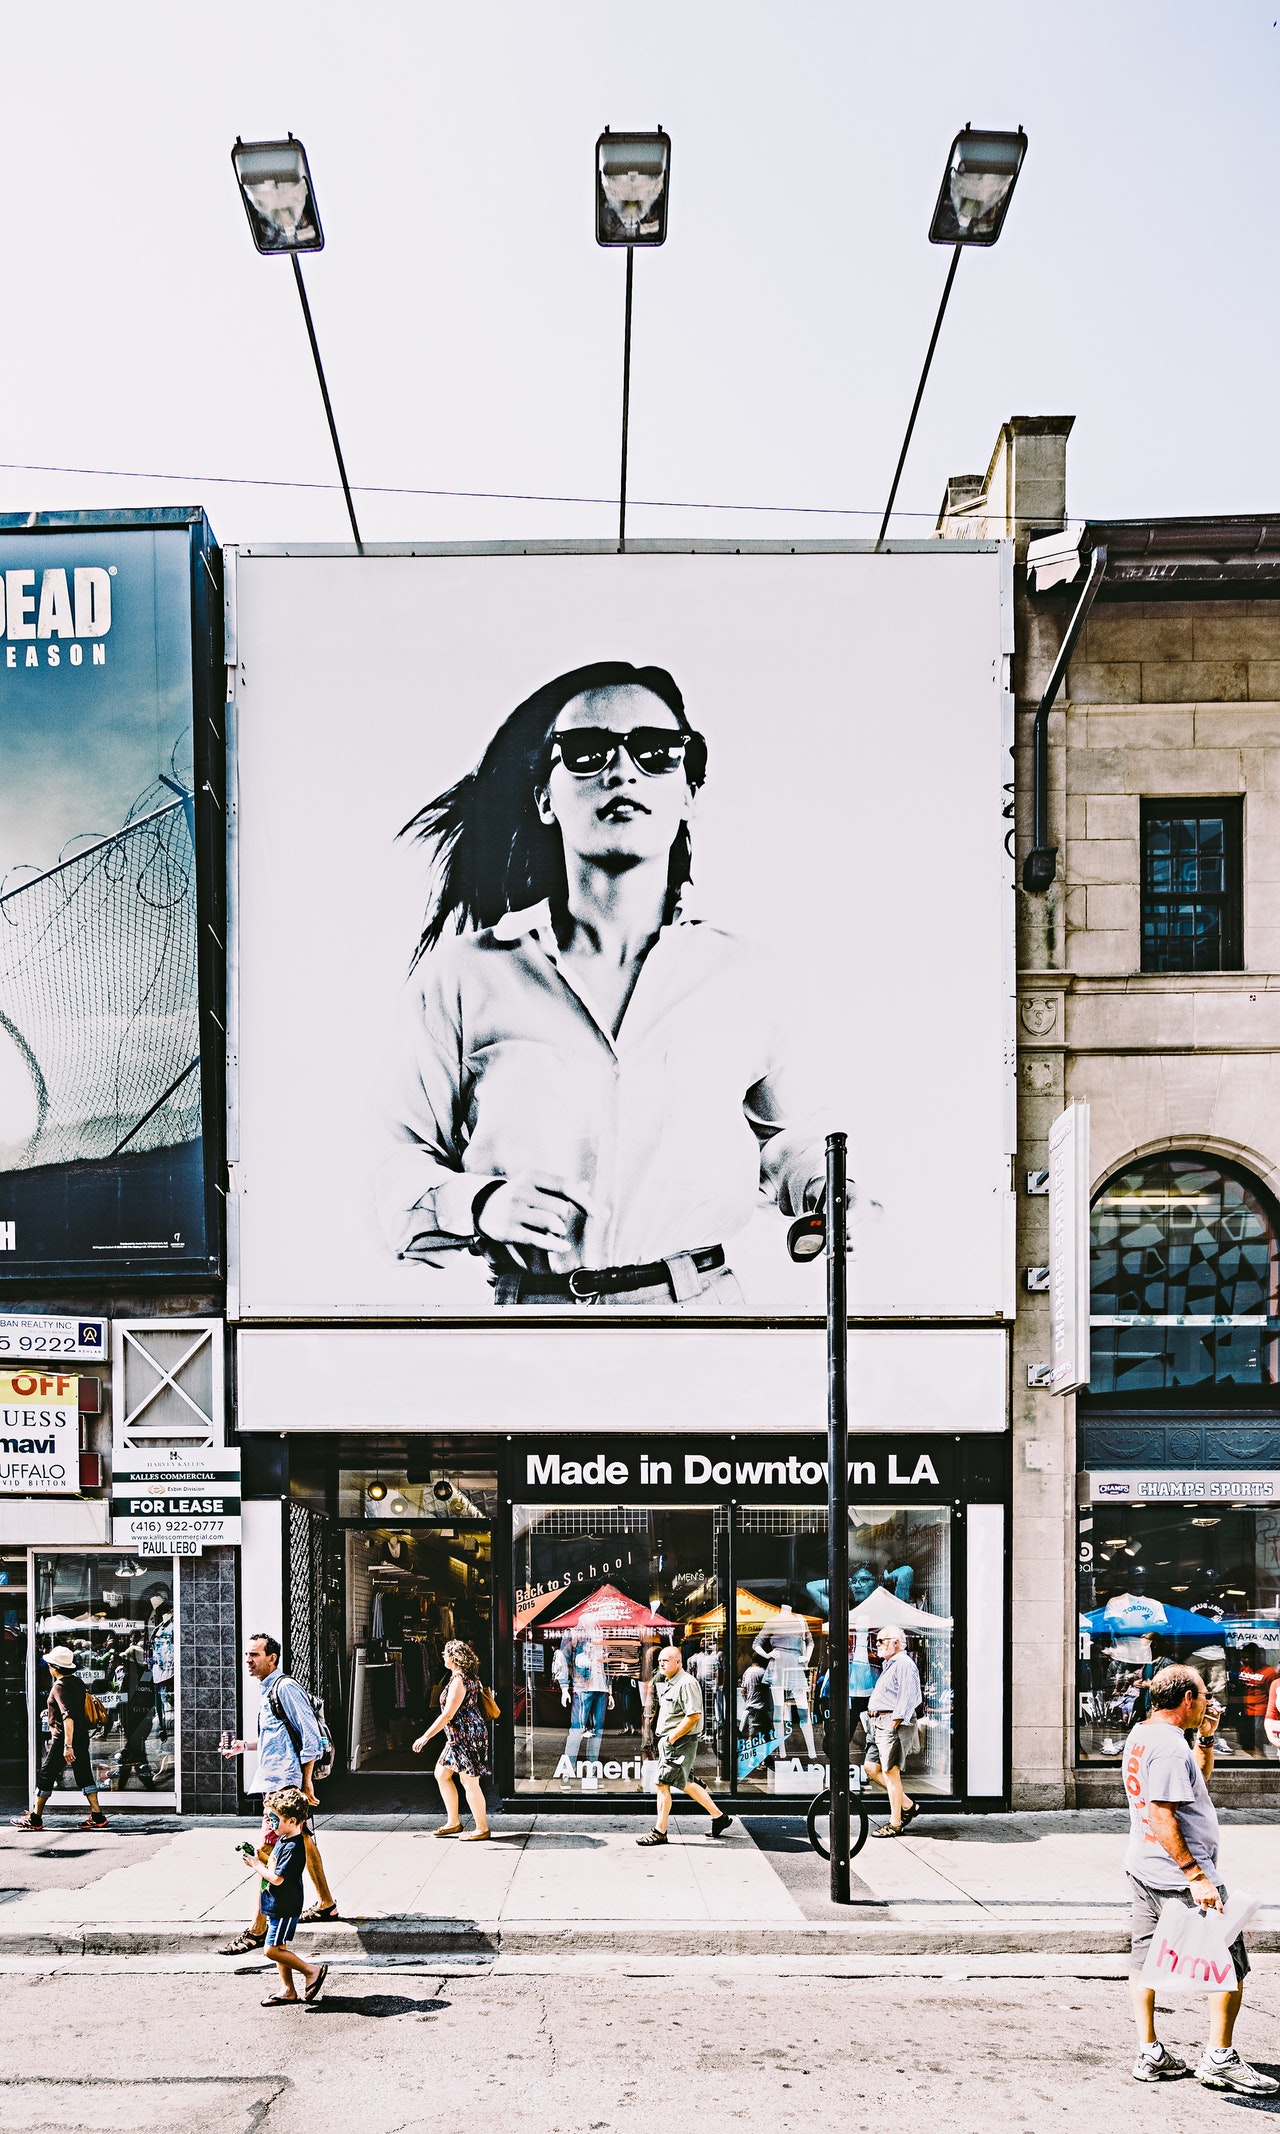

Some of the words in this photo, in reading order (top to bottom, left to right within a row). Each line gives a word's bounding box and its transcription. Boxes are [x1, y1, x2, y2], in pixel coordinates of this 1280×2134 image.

[0, 567, 112, 640] EAD
[21, 1320, 54, 1329] REALTY
[56, 1322, 75, 1330] INC.
[19, 1336, 76, 1352] 9222
[11, 1374, 71, 1396] OFF
[130, 1473, 159, 1481] KALLES
[160, 1472, 216, 1480] COMMERCIAL
[526, 1454, 629, 1485] Made
[640, 1454, 673, 1485] in
[888, 1454, 940, 1485] LA
[1138, 1482, 1205, 1497] CHAMPS
[1210, 1482, 1274, 1497] SPORTS
[130, 1500, 165, 1513] FOR
[169, 1500, 224, 1513] LEASE
[130, 1522, 162, 1532] (416)
[165, 1521, 224, 1531] 922-0777
[142, 1542, 167, 1553] PAUL
[170, 1542, 197, 1553] LEBO
[515, 1583, 544, 1602] Back
[547, 1580, 559, 1592] to
[563, 1551, 632, 1586] School
[517, 1600, 536, 1613] 2015
[738, 1732, 766, 1752] Back
[1156, 1939, 1232, 1984] hmv
